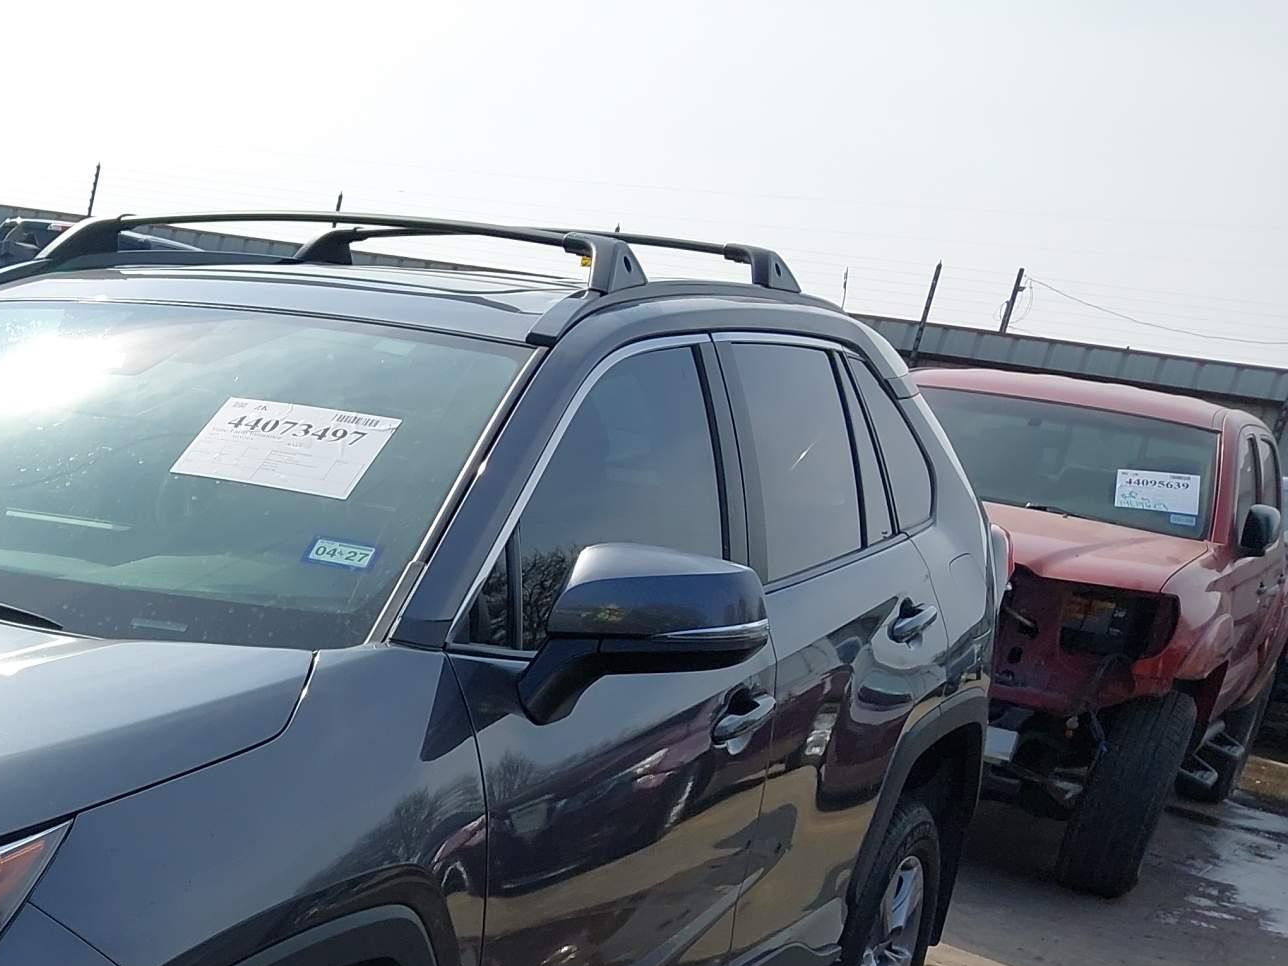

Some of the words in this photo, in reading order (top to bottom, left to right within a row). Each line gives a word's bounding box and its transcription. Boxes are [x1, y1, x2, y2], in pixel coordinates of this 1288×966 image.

[227, 415, 368, 446] 44073497
[1125, 478, 1190, 489] 44095639
[314, 545, 337, 558] 04
[344, 550, 369, 563] 27
